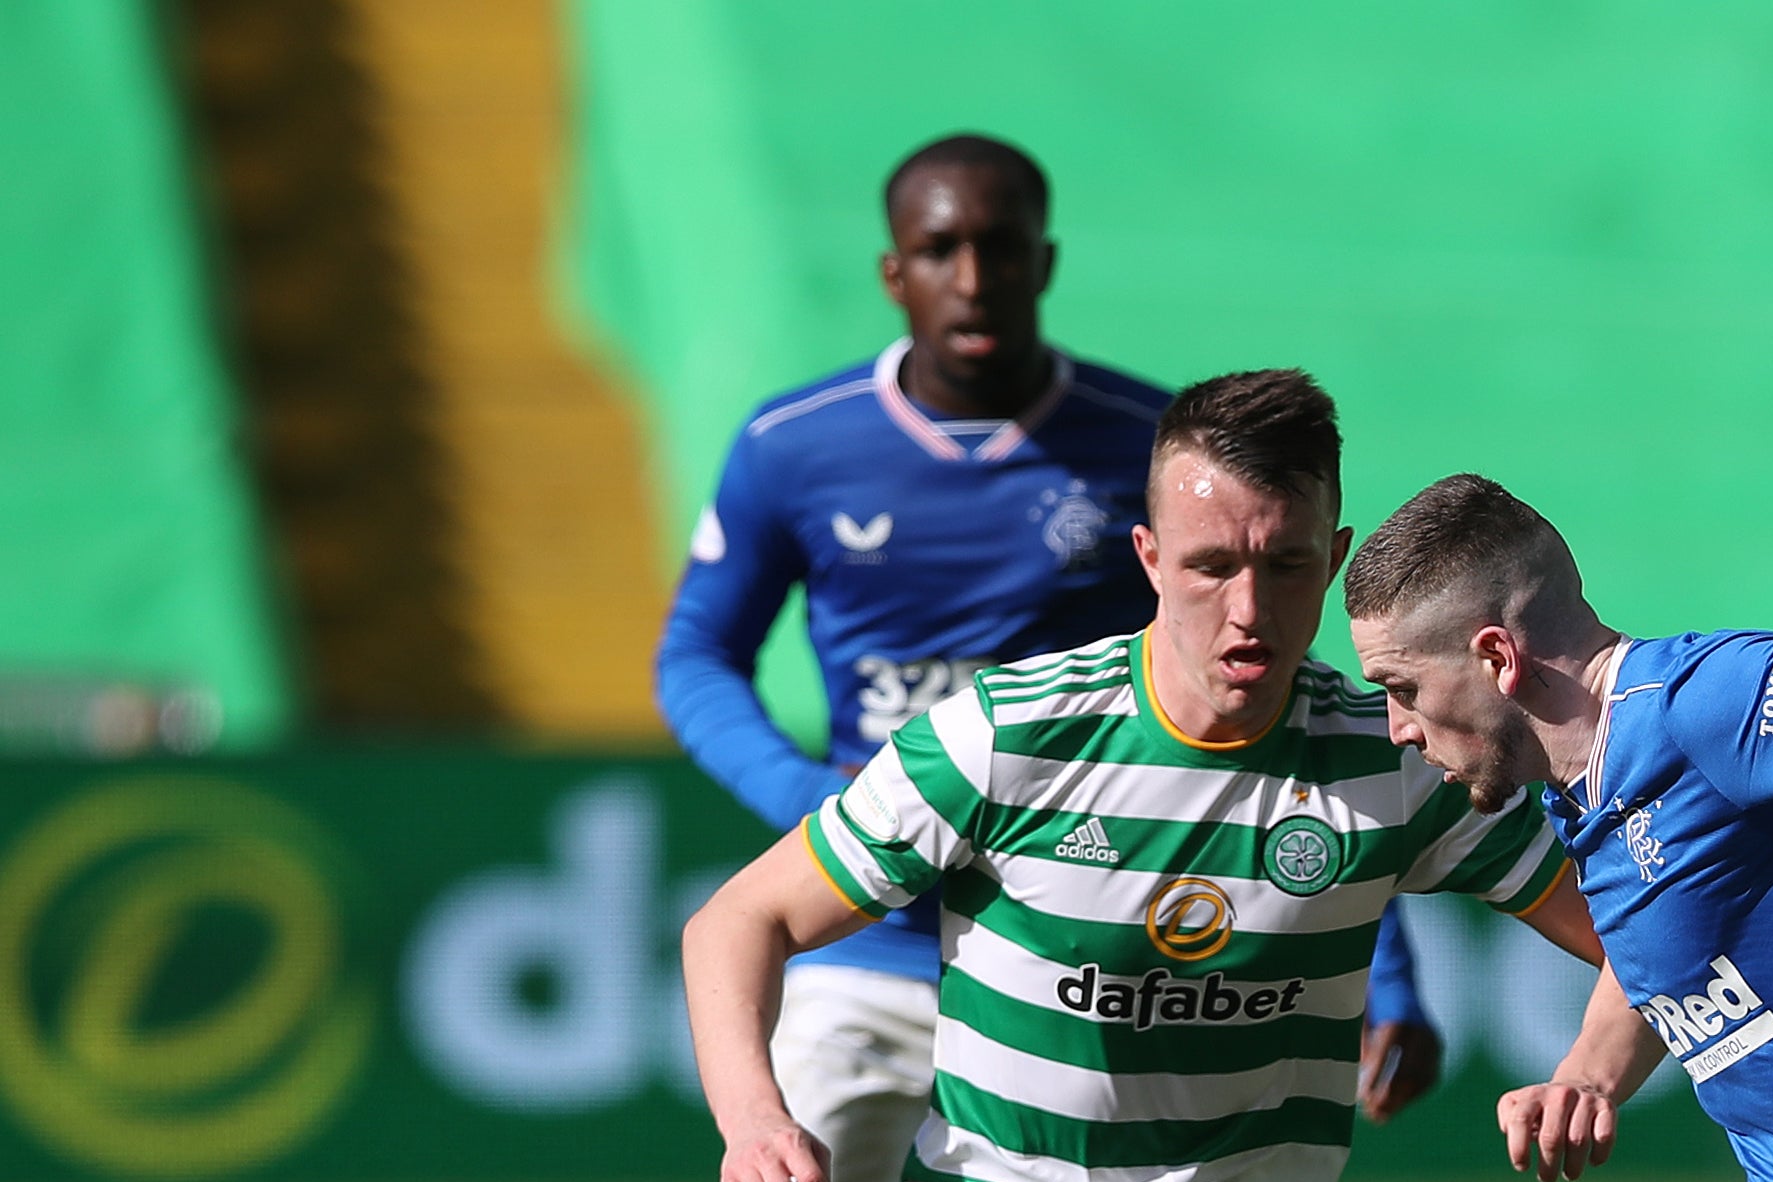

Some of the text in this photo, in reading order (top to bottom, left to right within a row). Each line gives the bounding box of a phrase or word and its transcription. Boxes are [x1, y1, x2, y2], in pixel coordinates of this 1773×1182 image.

[1055, 843, 1119, 863] adidas
[1056, 963, 1305, 1031] dafabet
[1704, 1037, 1749, 1070] CONTROL
